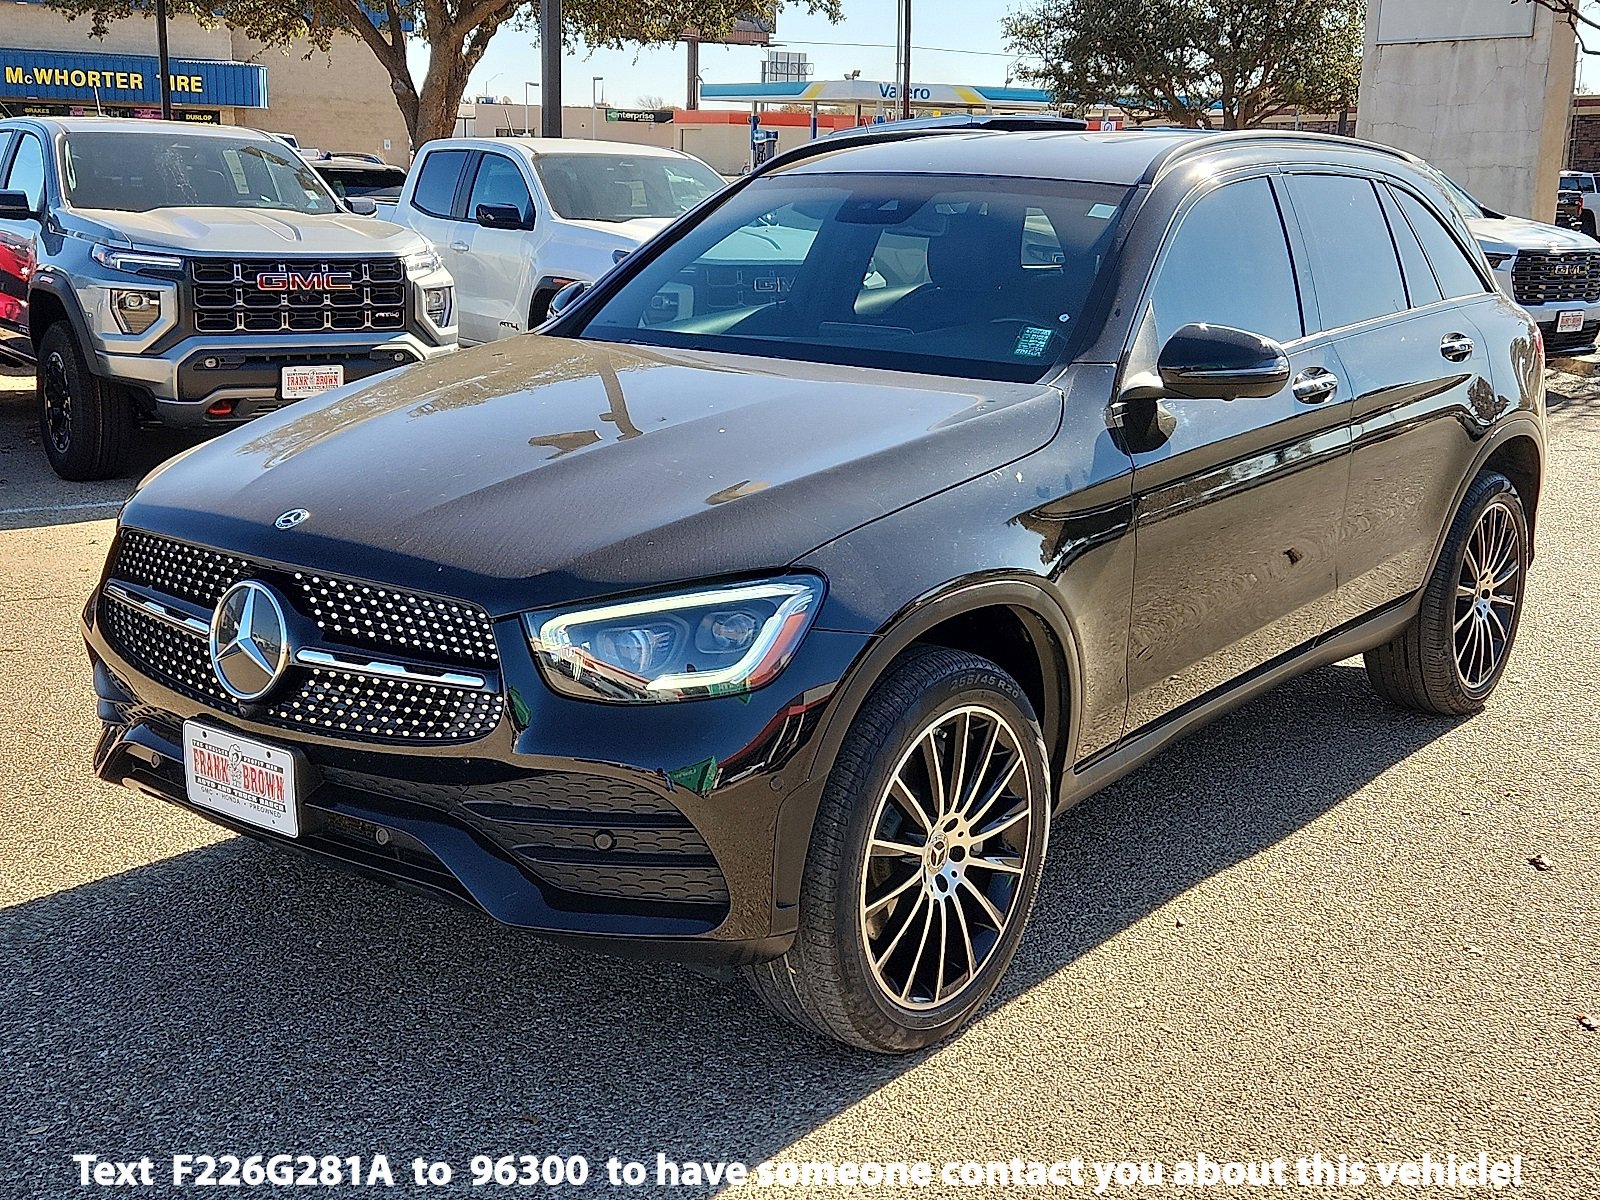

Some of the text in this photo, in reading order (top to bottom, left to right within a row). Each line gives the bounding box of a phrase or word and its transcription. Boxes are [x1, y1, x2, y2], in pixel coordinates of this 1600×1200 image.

[156, 74, 203, 93] IRE
[879, 83, 930, 99] Valro
[607, 111, 655, 121] enterprise
[257, 272, 352, 290] GMC
[193, 748, 285, 803] FRANK BROWN
[200, 786, 282, 819] GMC HONDA PREOWNED
[217, 783, 232, 794] AND
[233, 788, 259, 803] TRUCK
